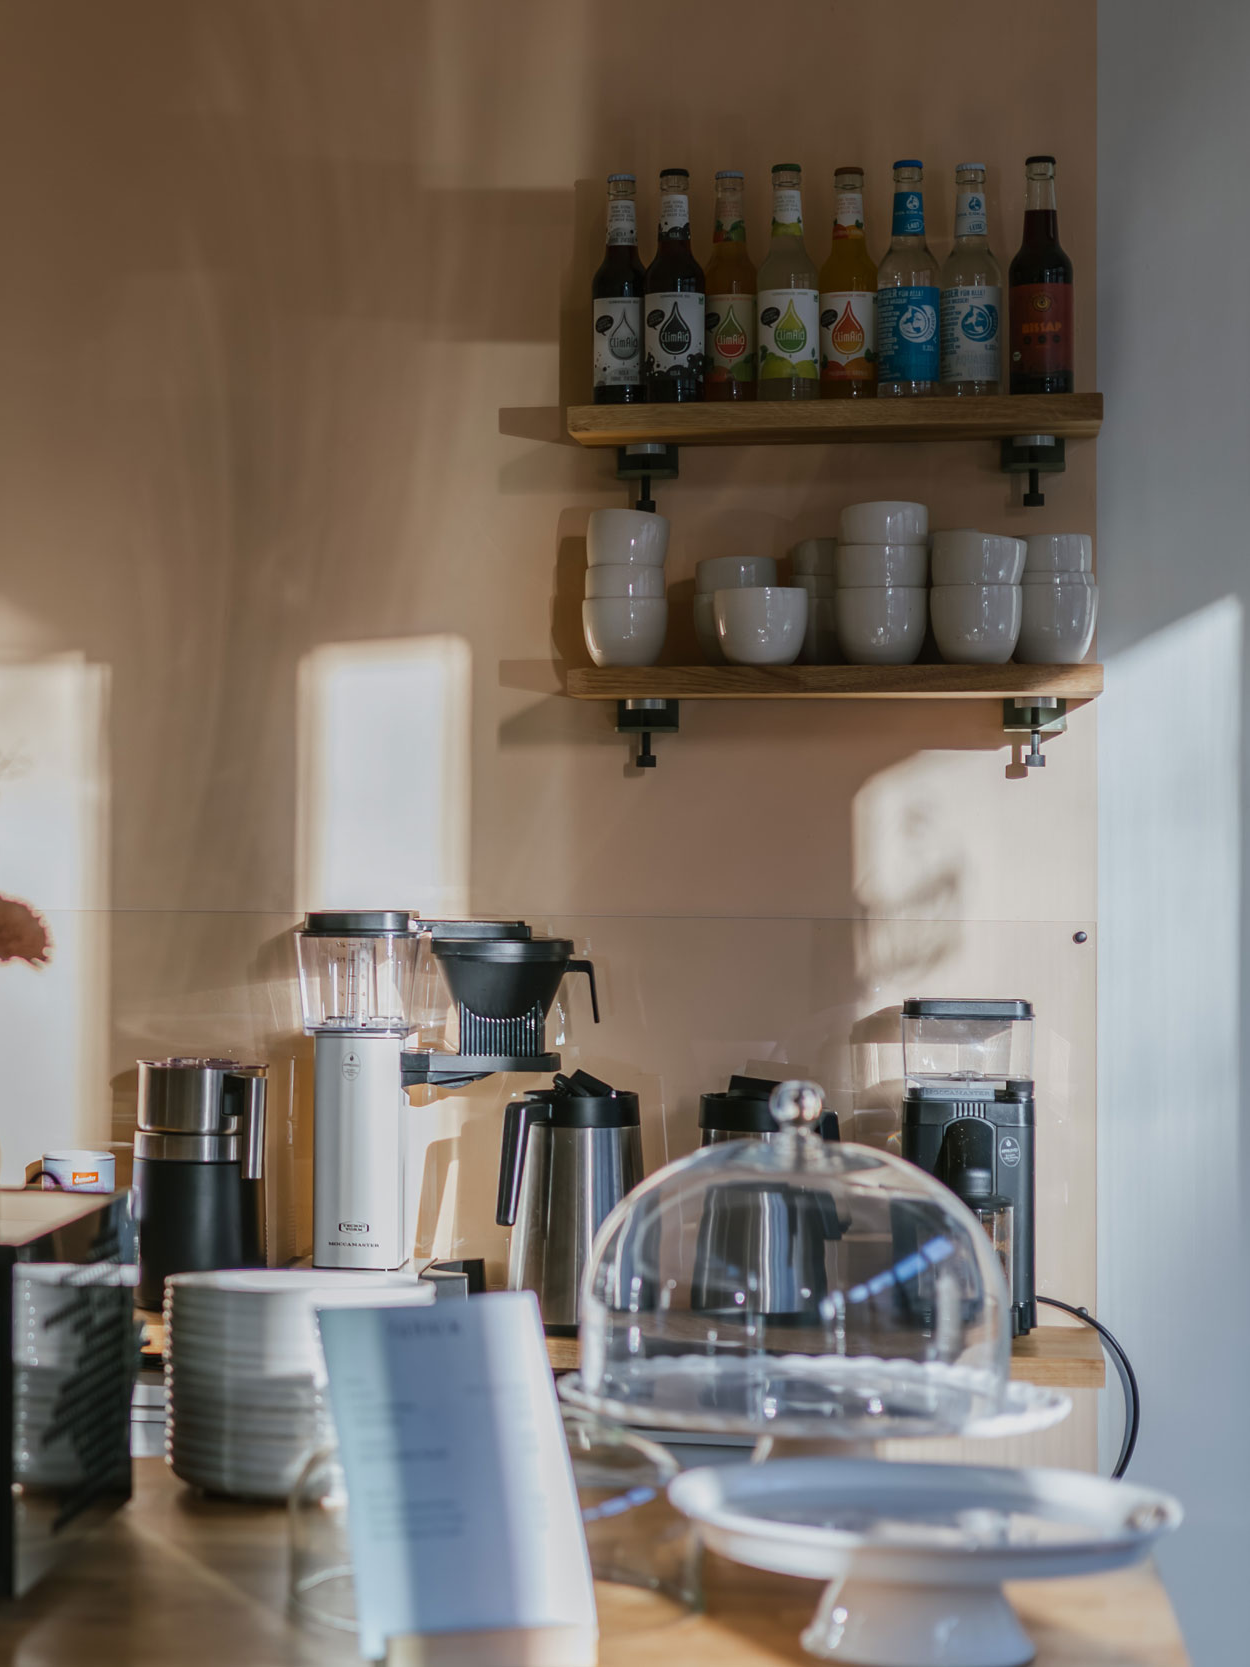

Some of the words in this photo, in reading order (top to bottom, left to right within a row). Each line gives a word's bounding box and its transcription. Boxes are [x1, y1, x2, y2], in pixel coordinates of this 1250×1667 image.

[661, 331, 689, 343] ClimAid
[716, 334, 746, 345] ClimAid
[776, 328, 805, 341] ClimAid
[833, 330, 863, 342] ClimAid
[609, 336, 638, 348] ClimAid
